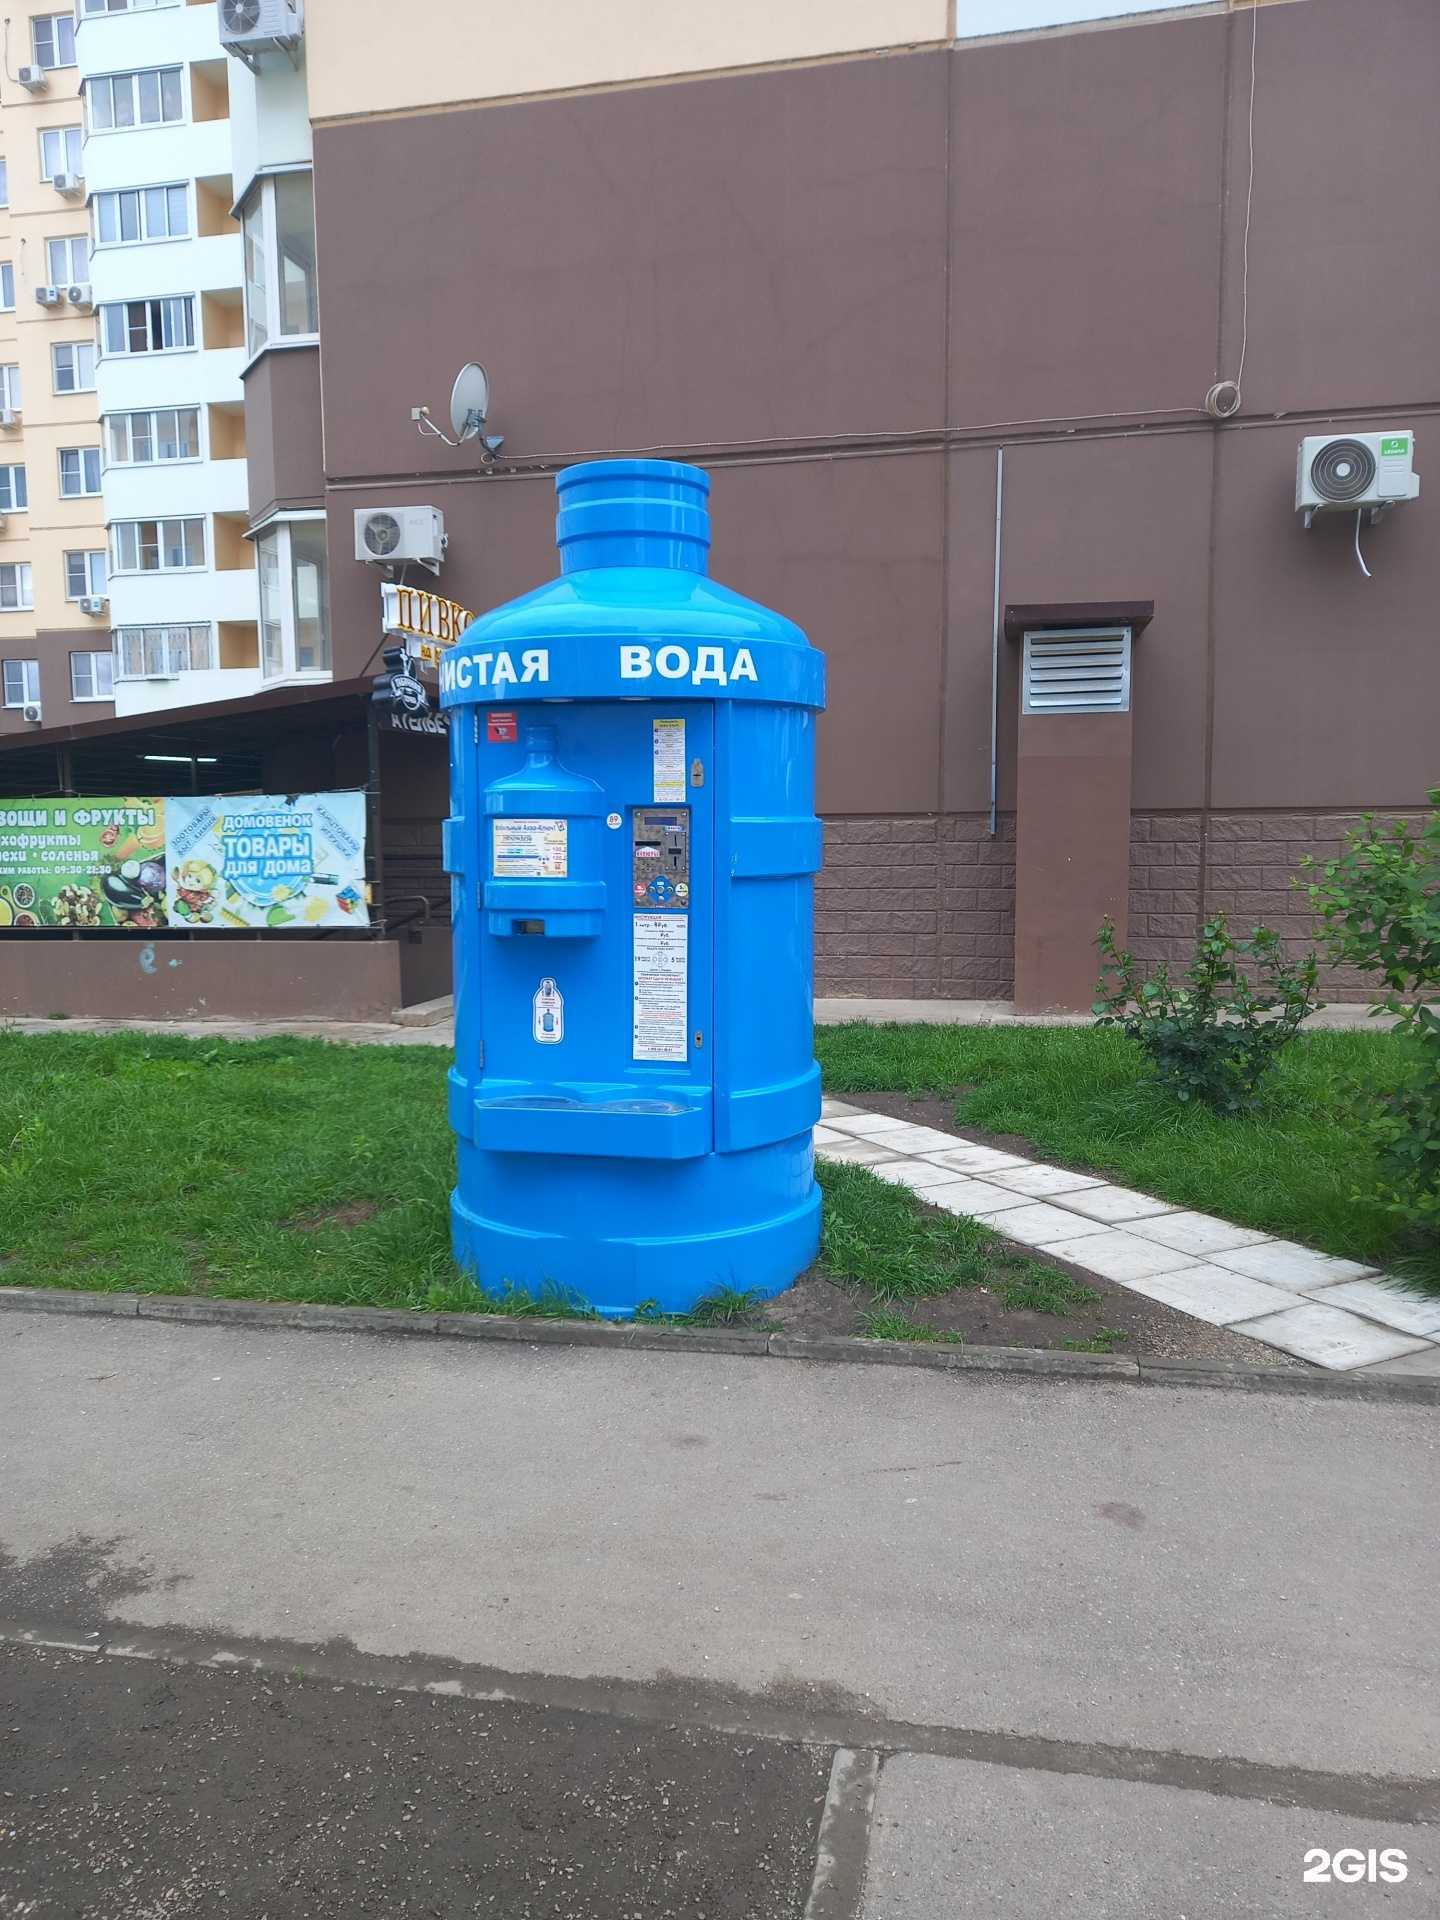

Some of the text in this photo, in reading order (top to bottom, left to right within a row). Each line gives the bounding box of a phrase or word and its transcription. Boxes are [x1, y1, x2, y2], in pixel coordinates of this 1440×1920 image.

[620, 645, 759, 687] ВОДА
[54, 809, 67, 826] И
[73, 808, 155, 826] ФРУКТЫ
[223, 813, 312, 832] ДОМОВЕНОК
[0, 850, 27, 862] ехи
[223, 835, 311, 858] ТОВАРЫ
